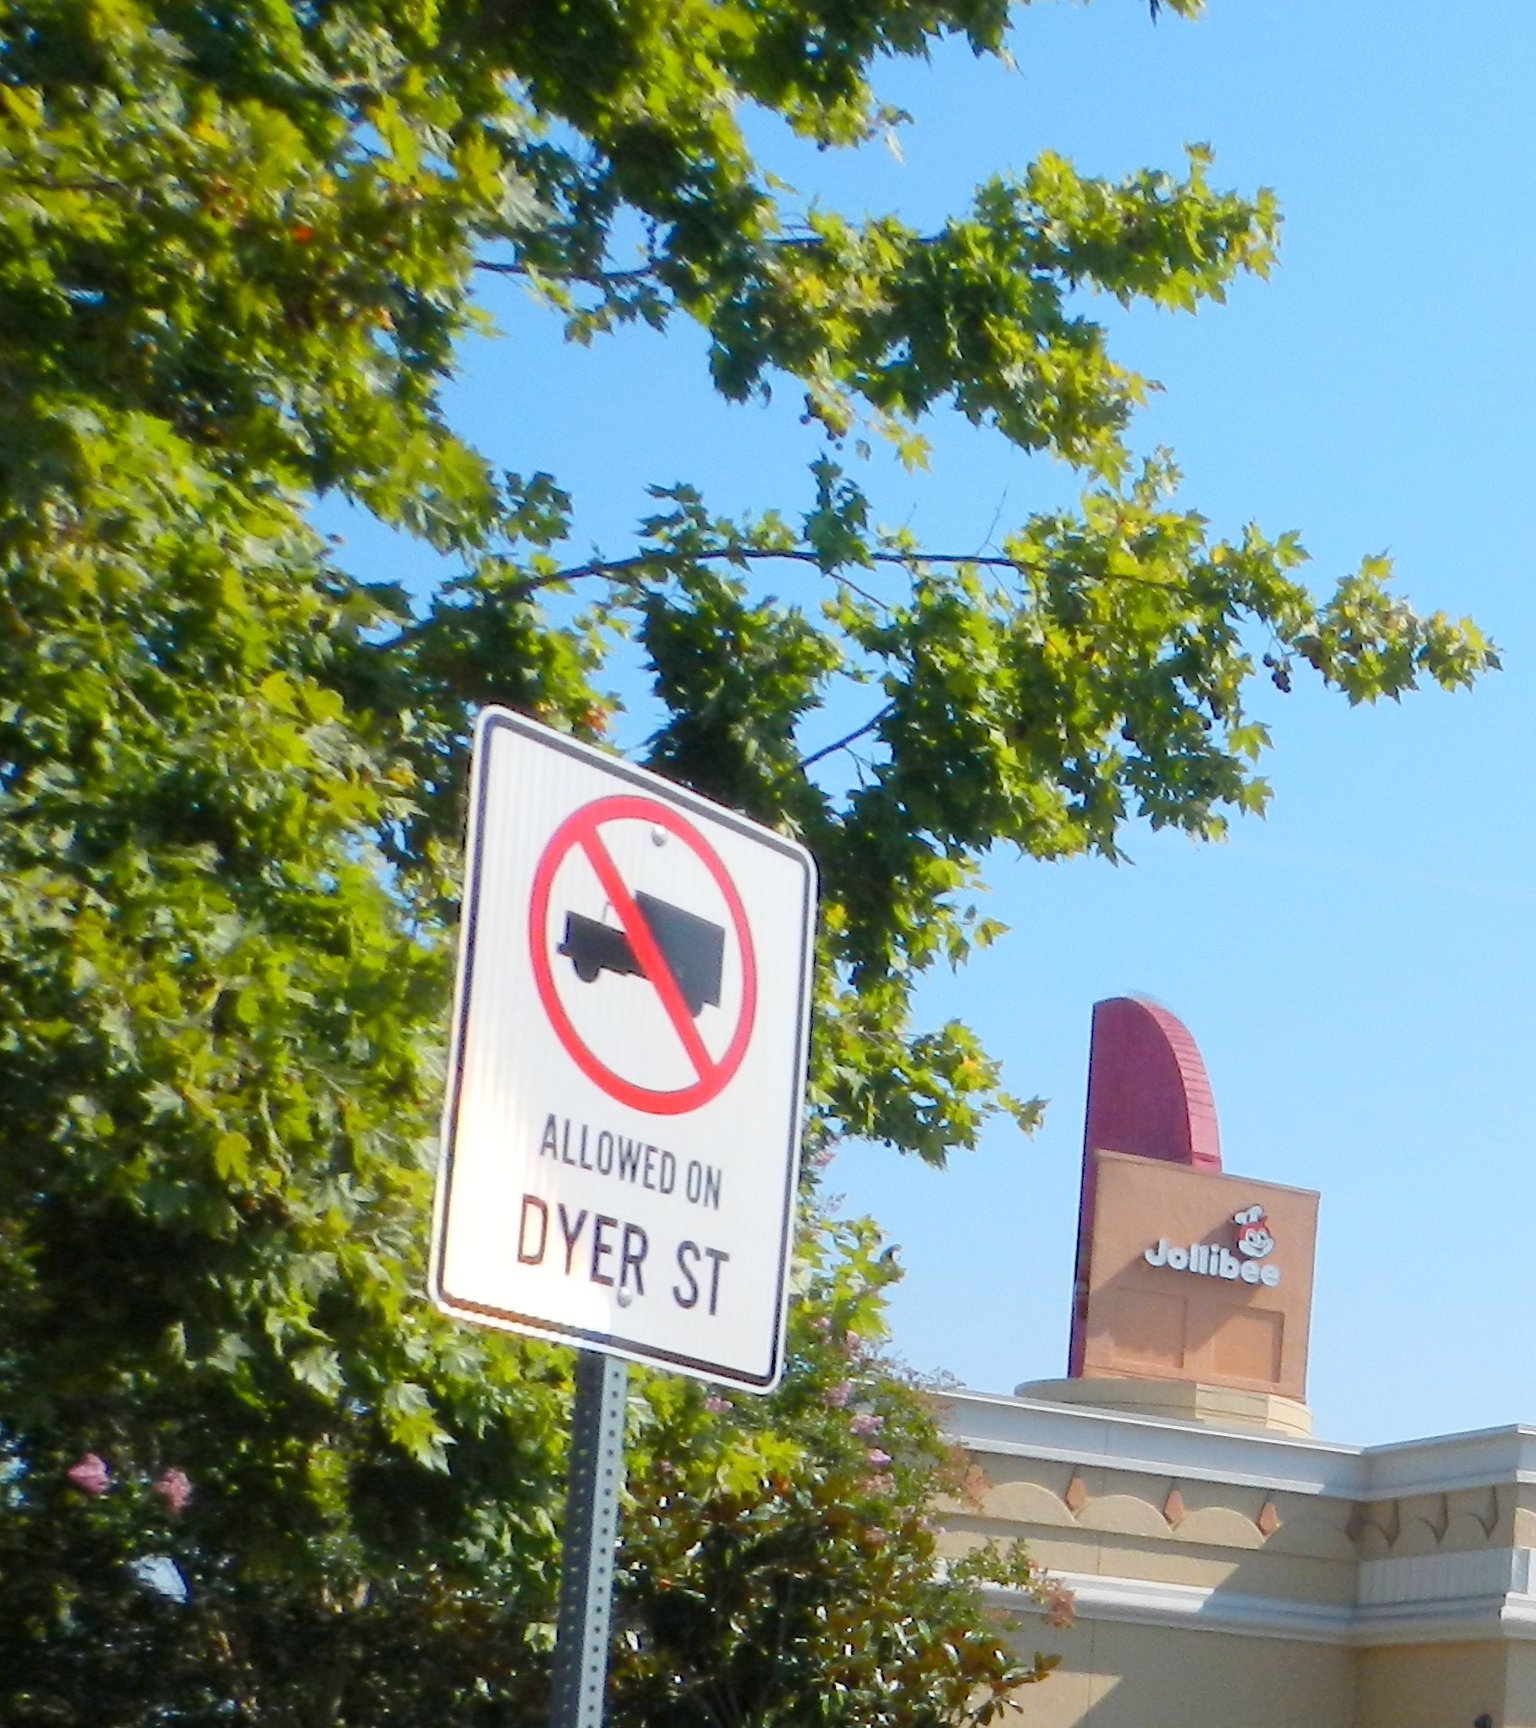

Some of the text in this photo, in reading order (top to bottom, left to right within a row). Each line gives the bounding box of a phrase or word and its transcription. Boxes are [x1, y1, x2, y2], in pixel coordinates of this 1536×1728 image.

[539, 1113, 723, 1211] ALLOWED ON
[517, 1194, 731, 1317] DYER ST
[1144, 1237, 1281, 1288] Jollibee
